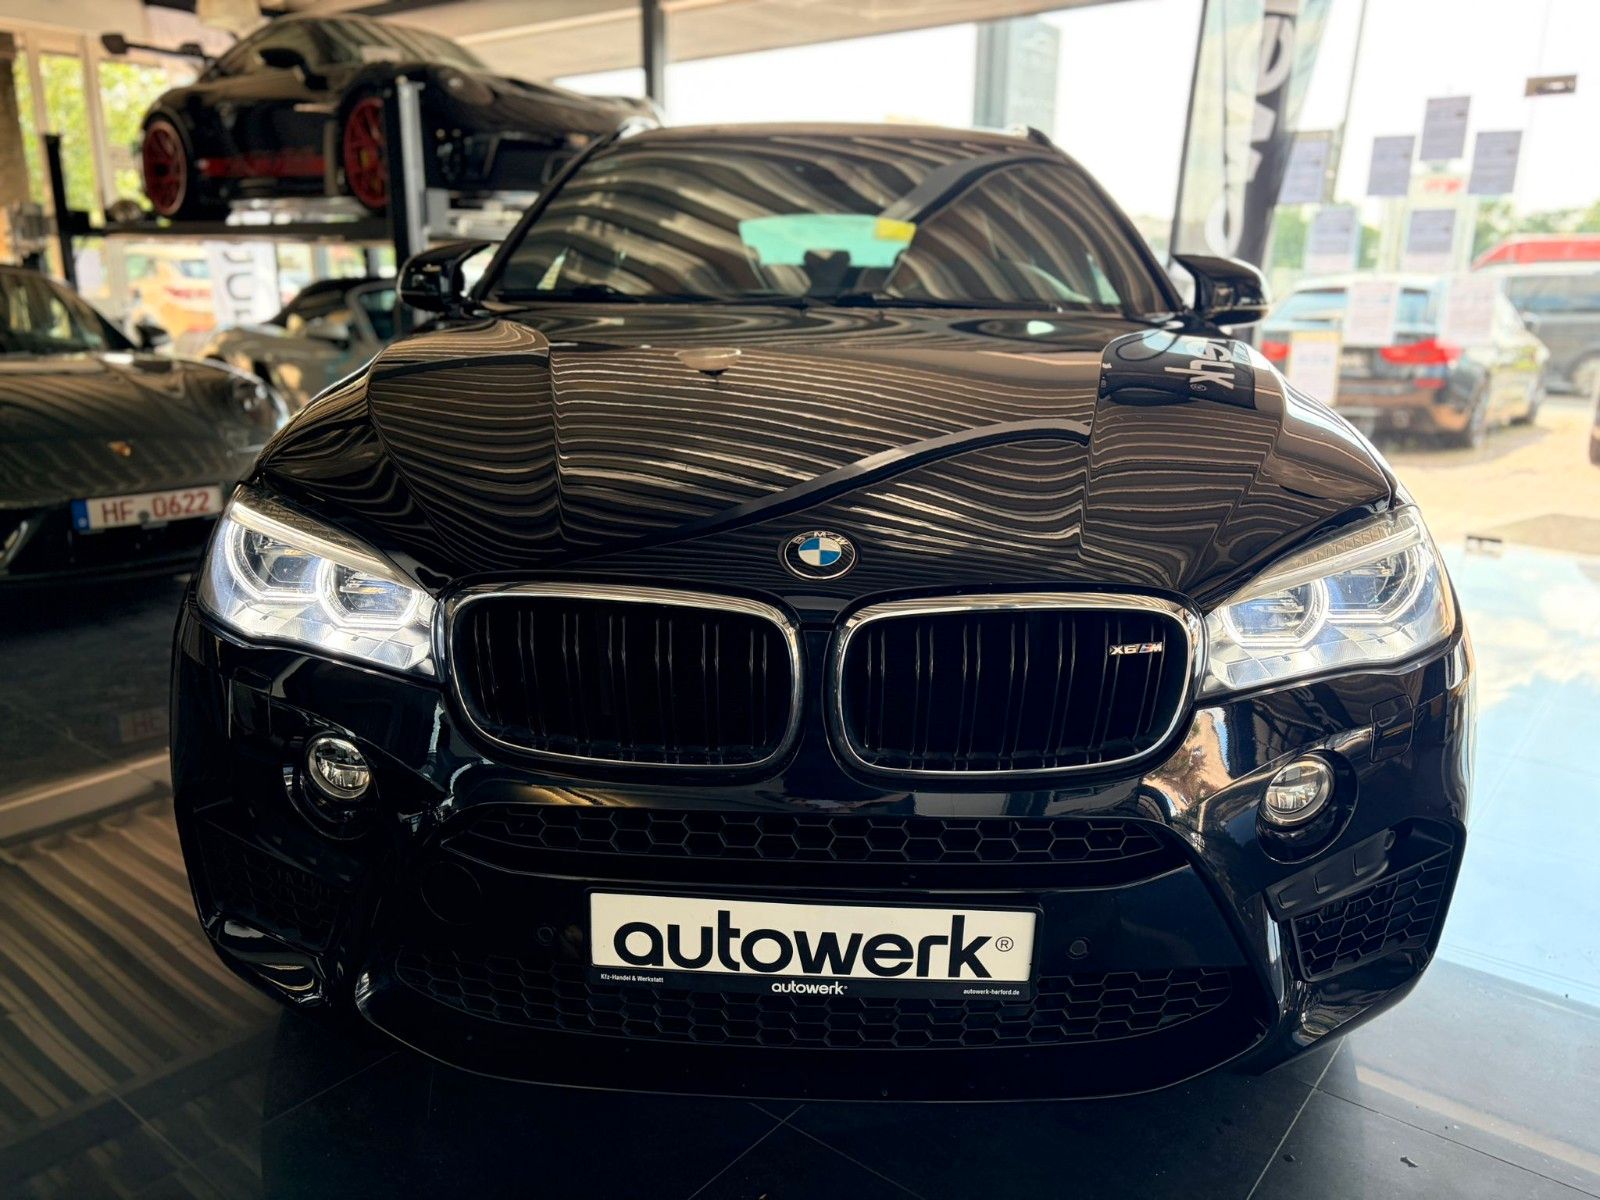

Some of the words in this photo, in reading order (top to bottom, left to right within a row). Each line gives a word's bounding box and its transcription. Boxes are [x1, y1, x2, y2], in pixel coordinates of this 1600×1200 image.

[102, 500, 133, 523] HF
[152, 491, 209, 518] 0622
[600, 973, 632, 981] Kfz-Handel
